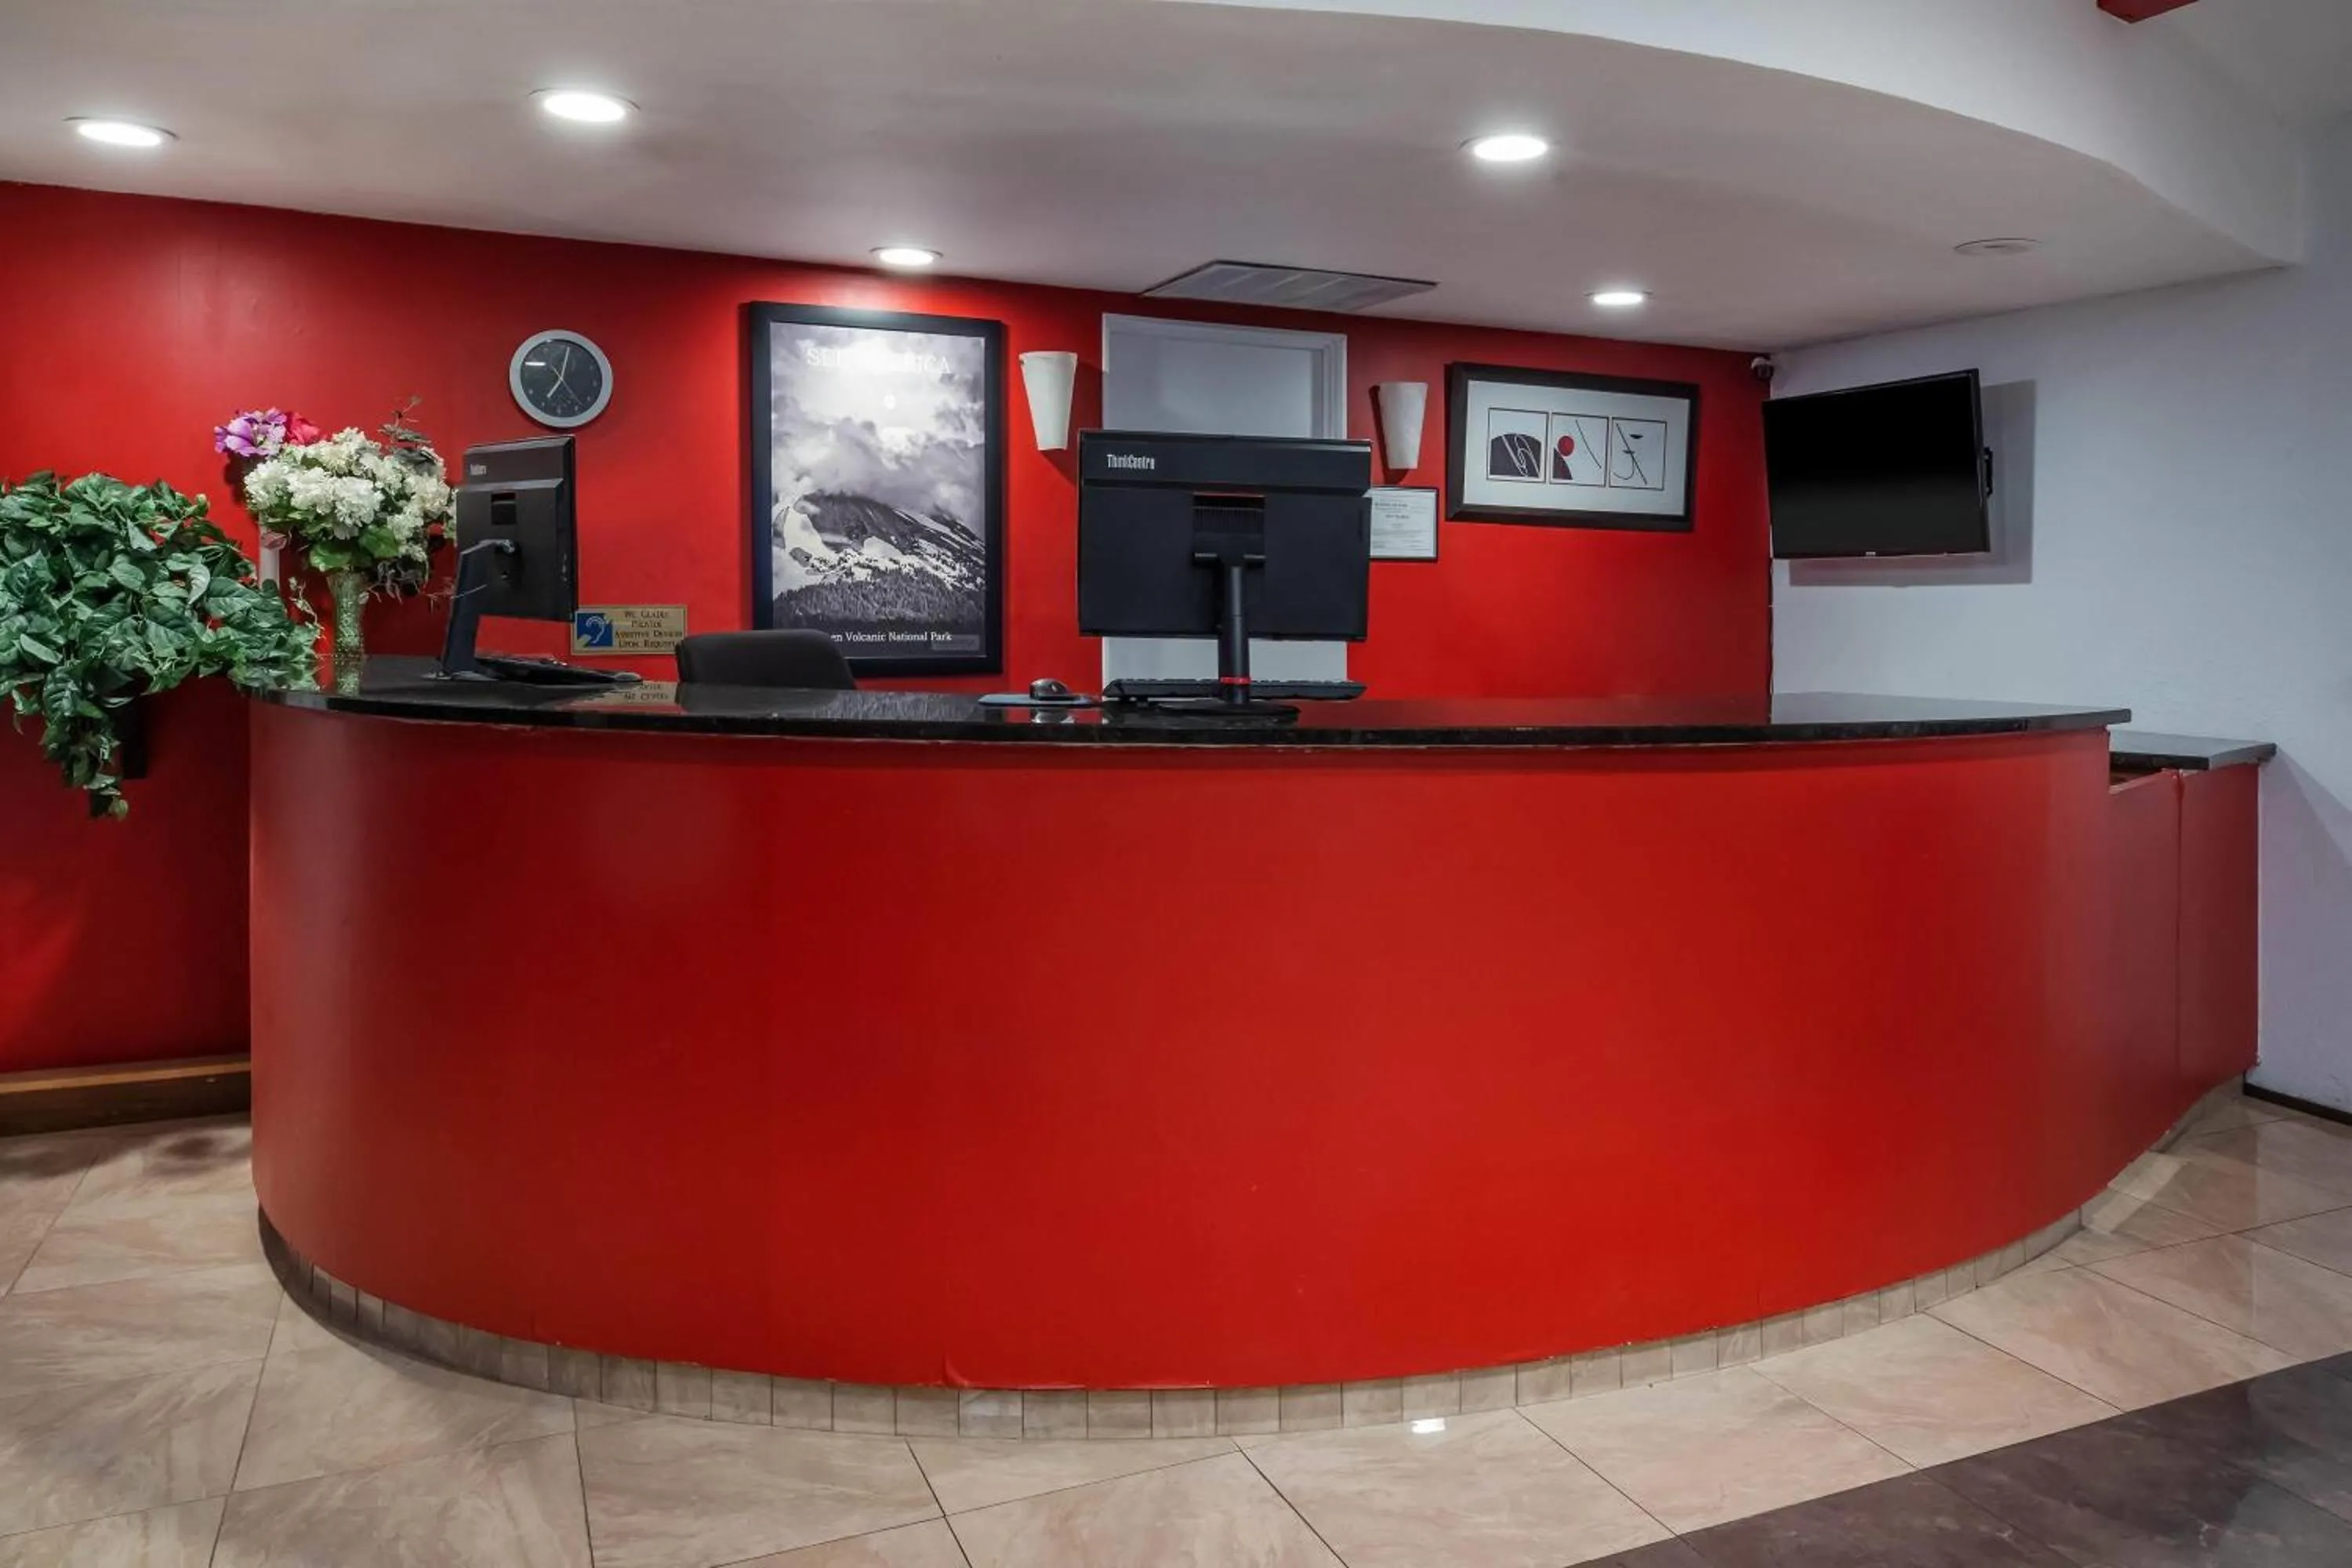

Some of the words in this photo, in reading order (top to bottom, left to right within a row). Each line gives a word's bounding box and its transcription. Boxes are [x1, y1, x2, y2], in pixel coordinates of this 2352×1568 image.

[1106, 453, 1155, 470] ThinkCentre
[845, 631, 887, 642] Volcanic
[888, 631, 927, 641] National
[930, 631, 953, 641] Park
